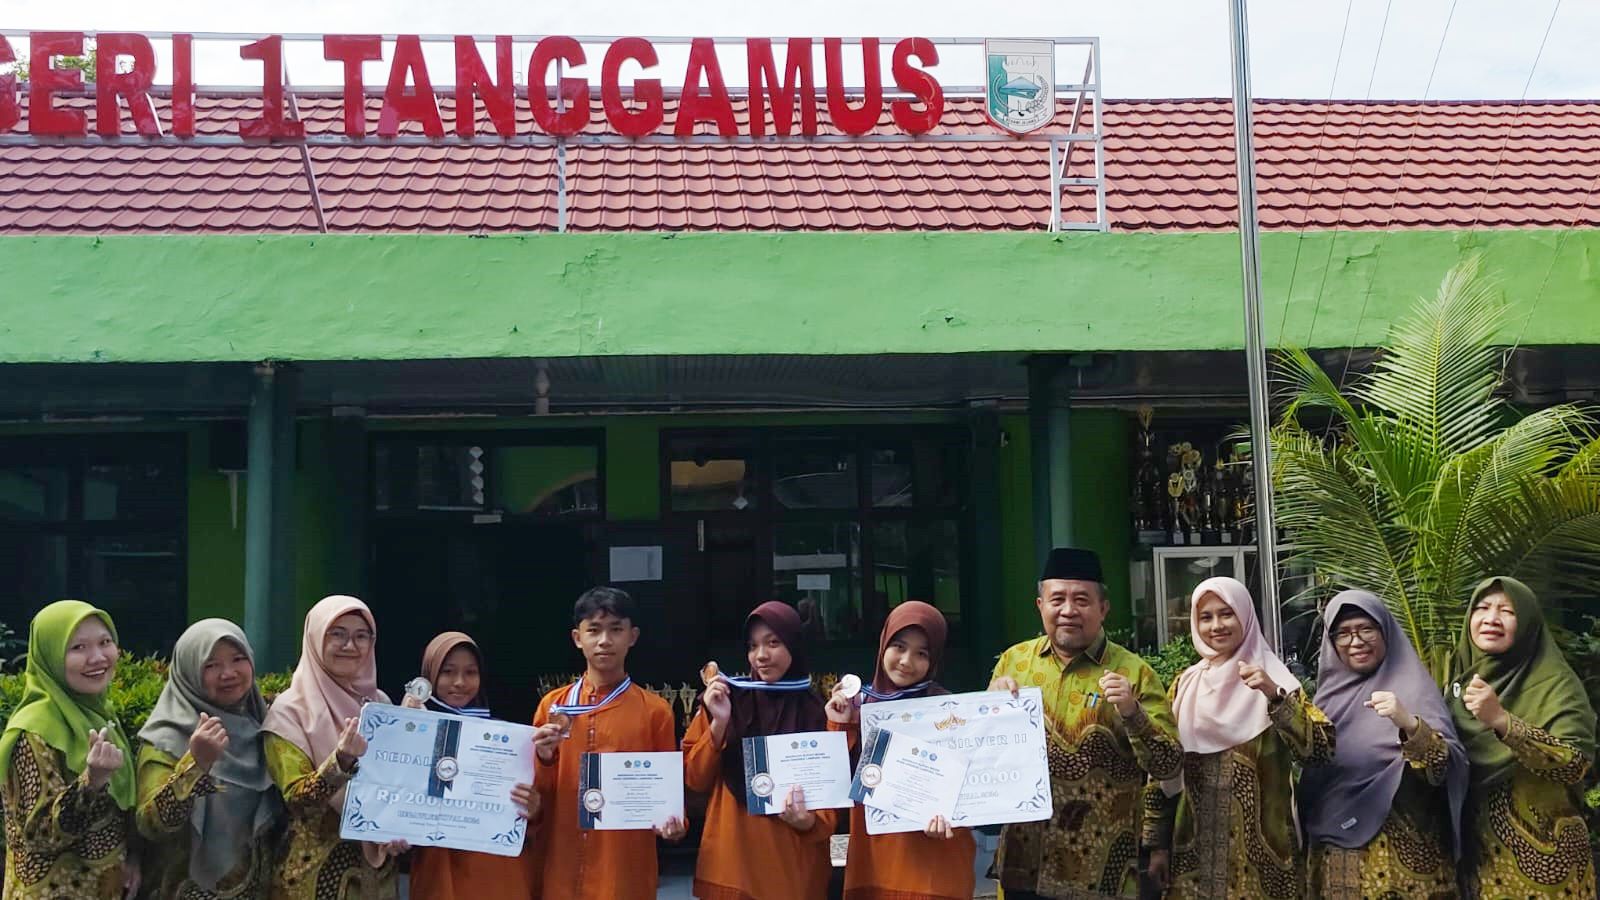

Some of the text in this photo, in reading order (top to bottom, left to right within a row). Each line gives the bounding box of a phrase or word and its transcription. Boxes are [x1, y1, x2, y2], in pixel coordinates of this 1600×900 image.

[239, 35, 305, 138] 1
[323, 34, 945, 137] TANGGAMUS
[948, 734, 1008, 750] SILVER
[376, 788, 400, 805] Rp
